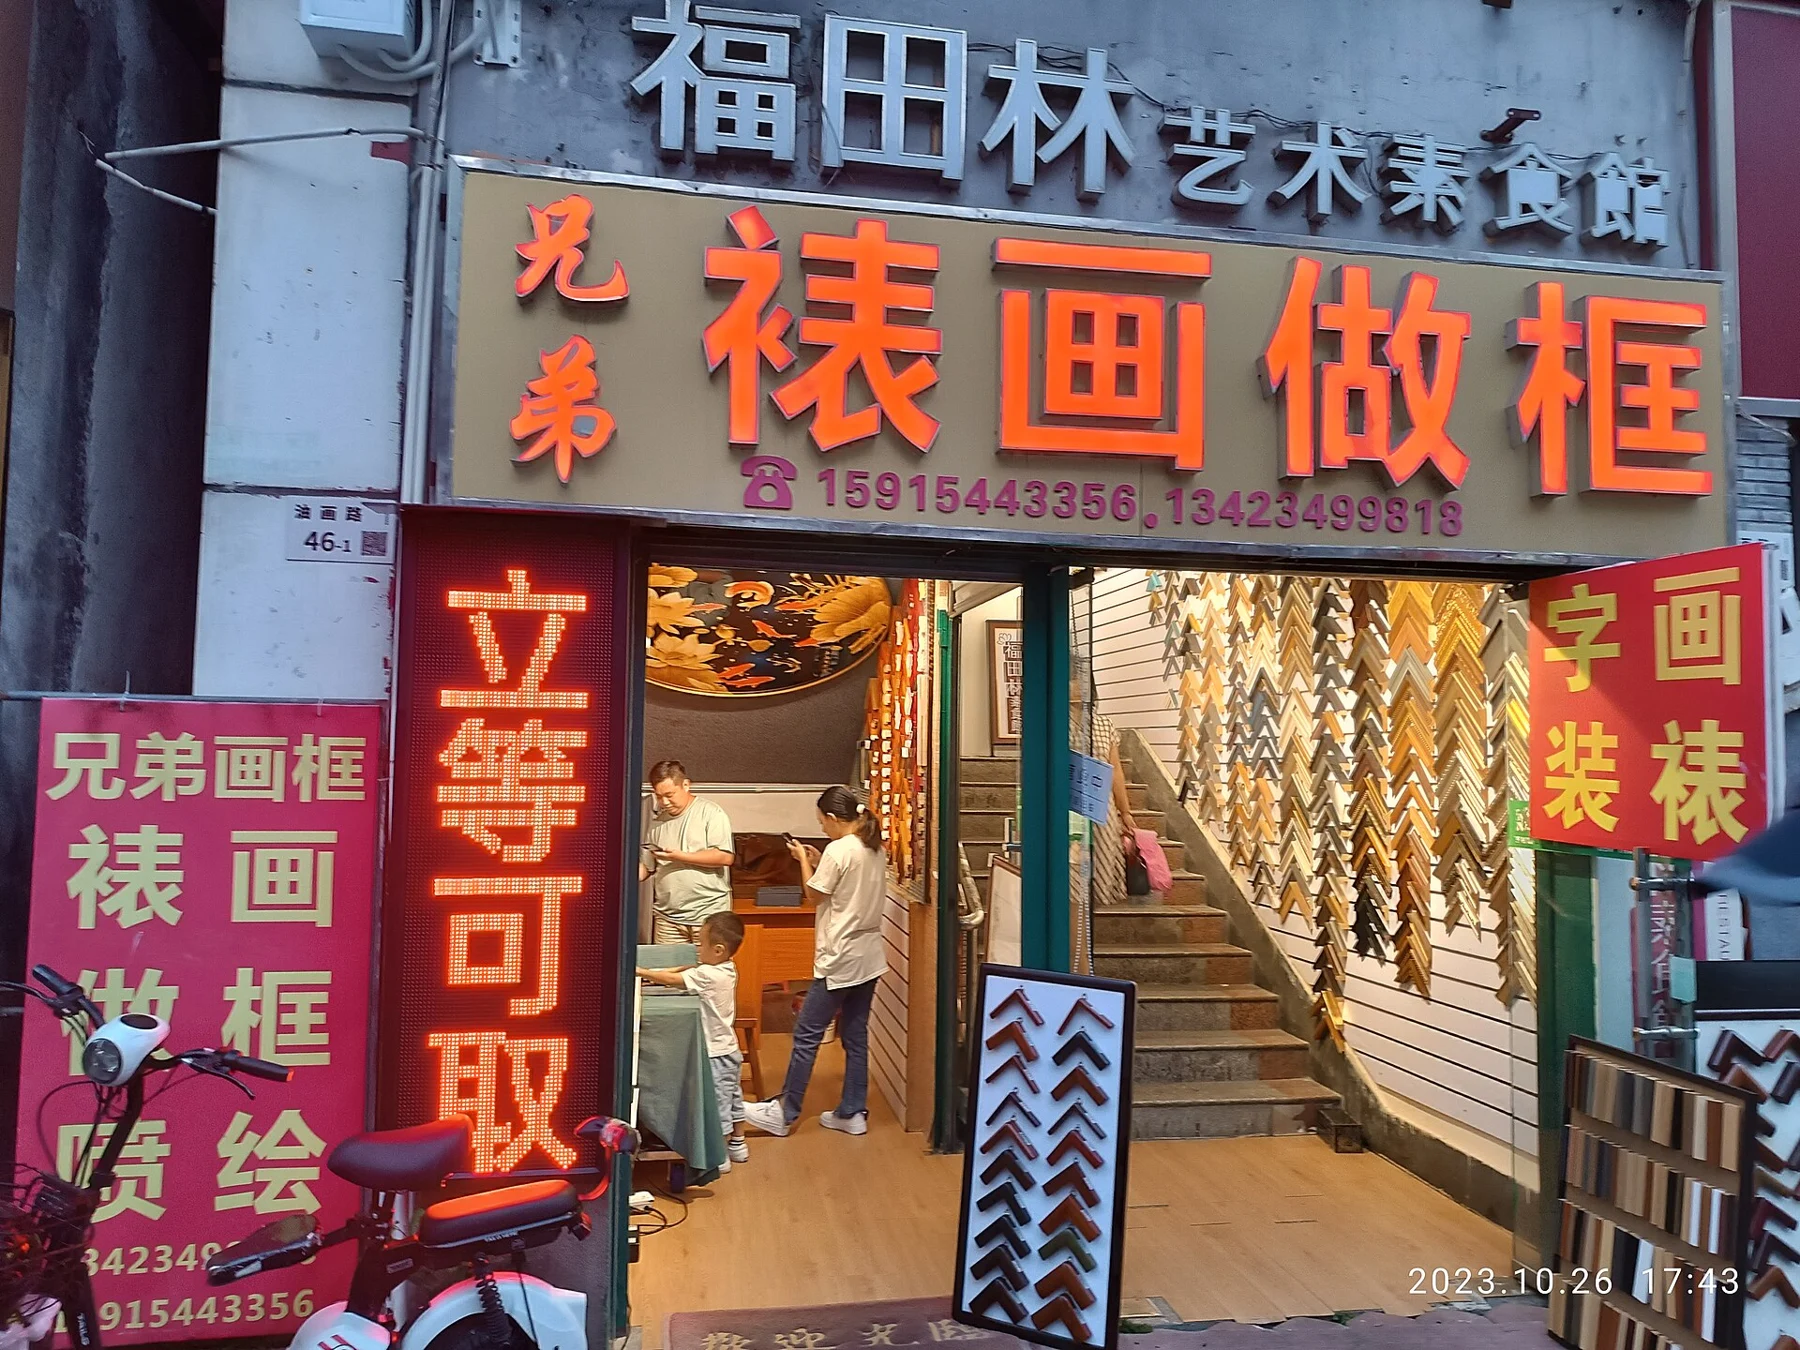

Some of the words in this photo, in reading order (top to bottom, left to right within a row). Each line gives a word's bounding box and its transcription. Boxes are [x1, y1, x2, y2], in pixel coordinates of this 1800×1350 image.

[45, 731, 367, 803] 兄弟画框
[427, 568, 590, 1174] 立等可取
